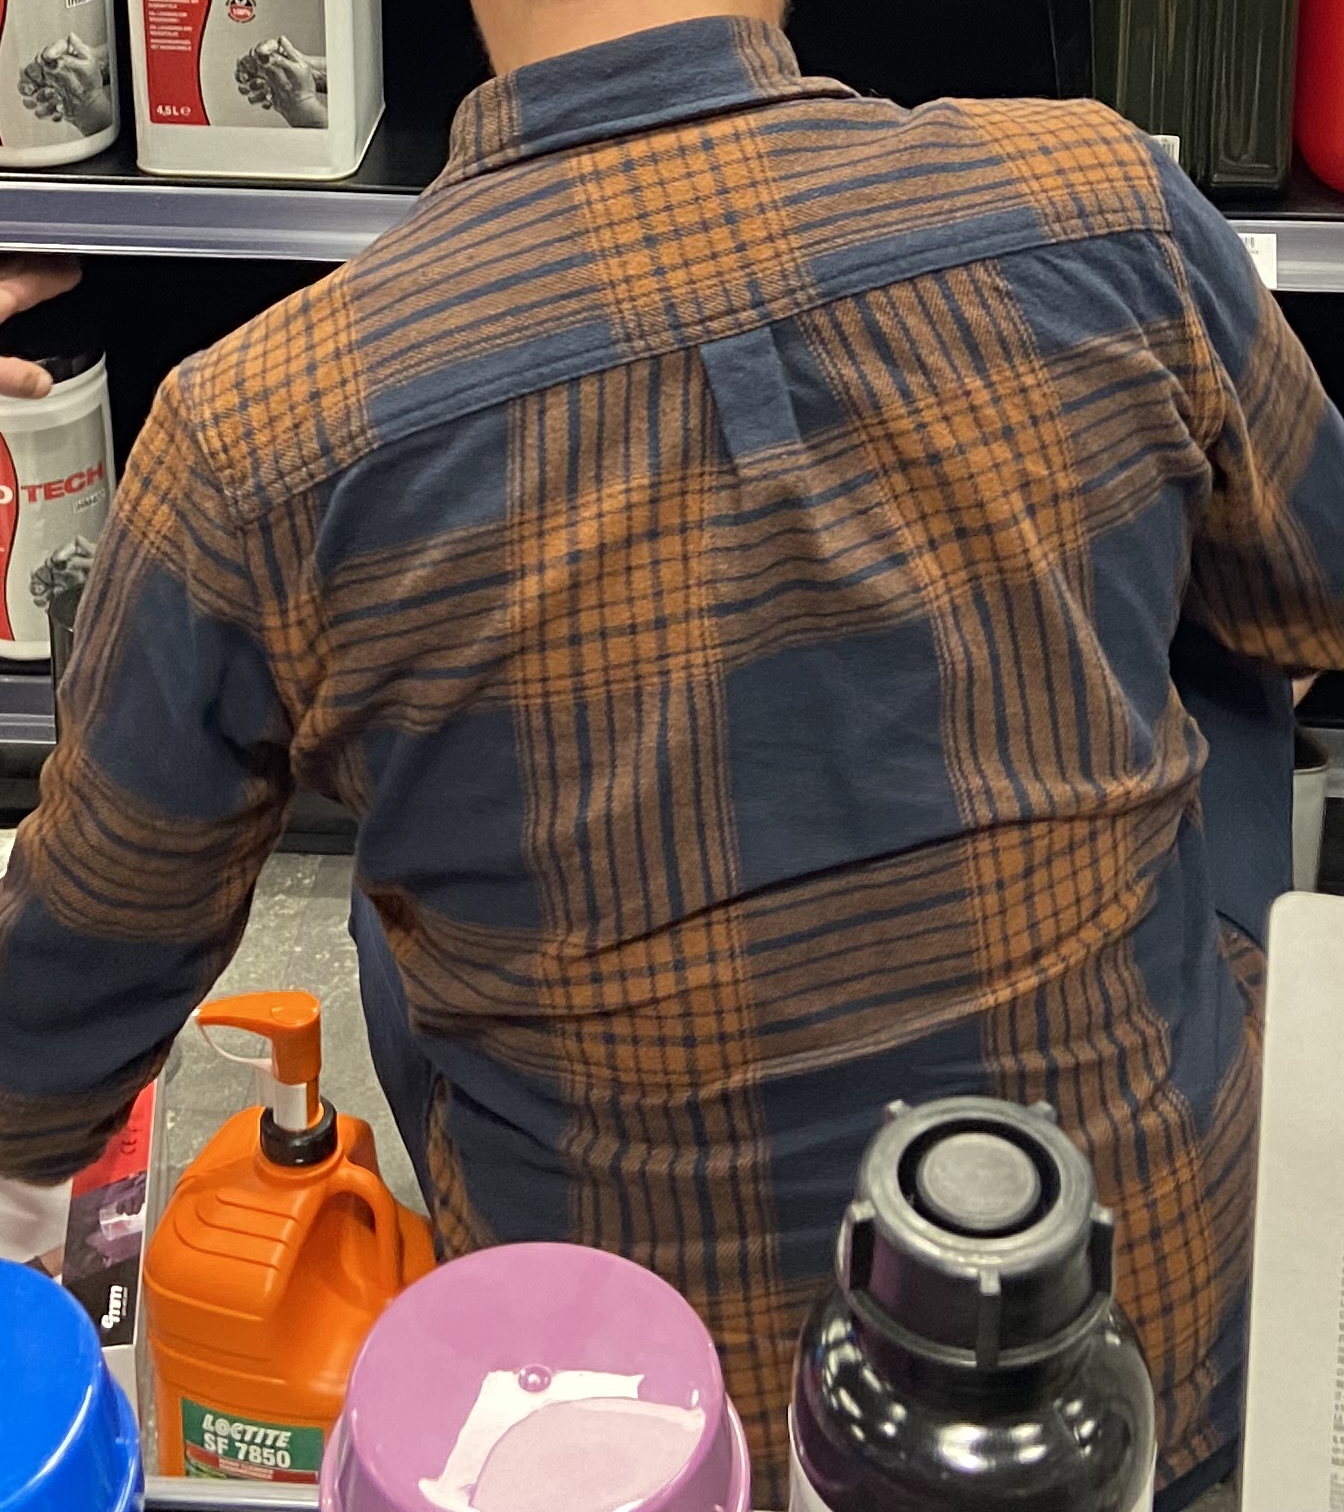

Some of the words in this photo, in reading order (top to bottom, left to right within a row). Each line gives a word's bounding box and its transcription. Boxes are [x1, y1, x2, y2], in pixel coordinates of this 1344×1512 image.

[20, 459, 105, 504] TECH
[202, 1413, 292, 1448] LOCTITE
[203, 1431, 229, 1456] SF
[235, 1439, 292, 1469] 7850
